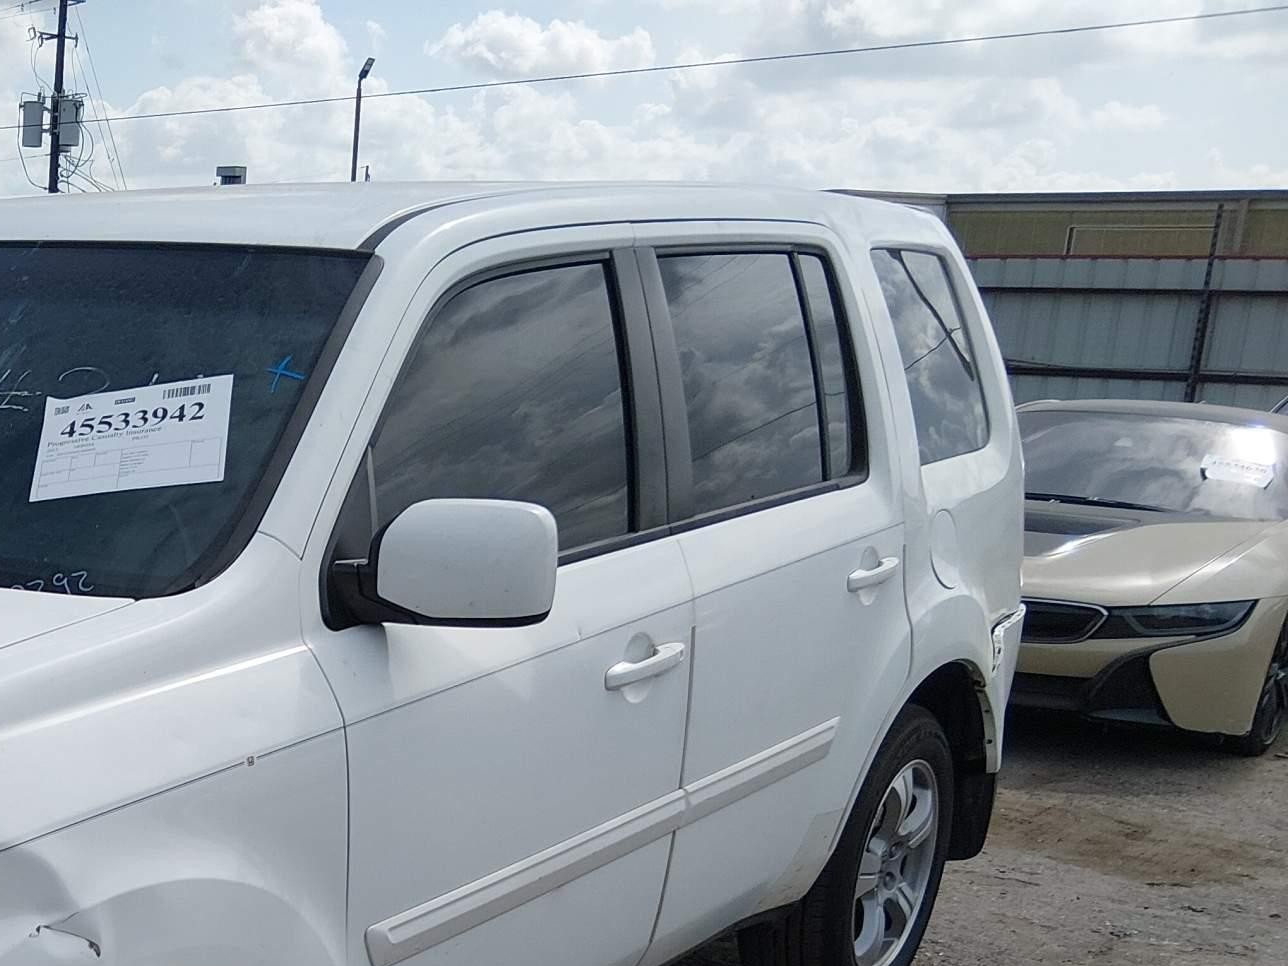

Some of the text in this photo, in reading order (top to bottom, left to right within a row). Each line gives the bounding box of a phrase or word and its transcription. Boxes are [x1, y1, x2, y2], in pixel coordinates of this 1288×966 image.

[59, 400, 206, 438] 45533942
[47, 435, 95, 448] Progressive
[91, 430, 124, 442] Casualty
[125, 426, 163, 437] Insurance
